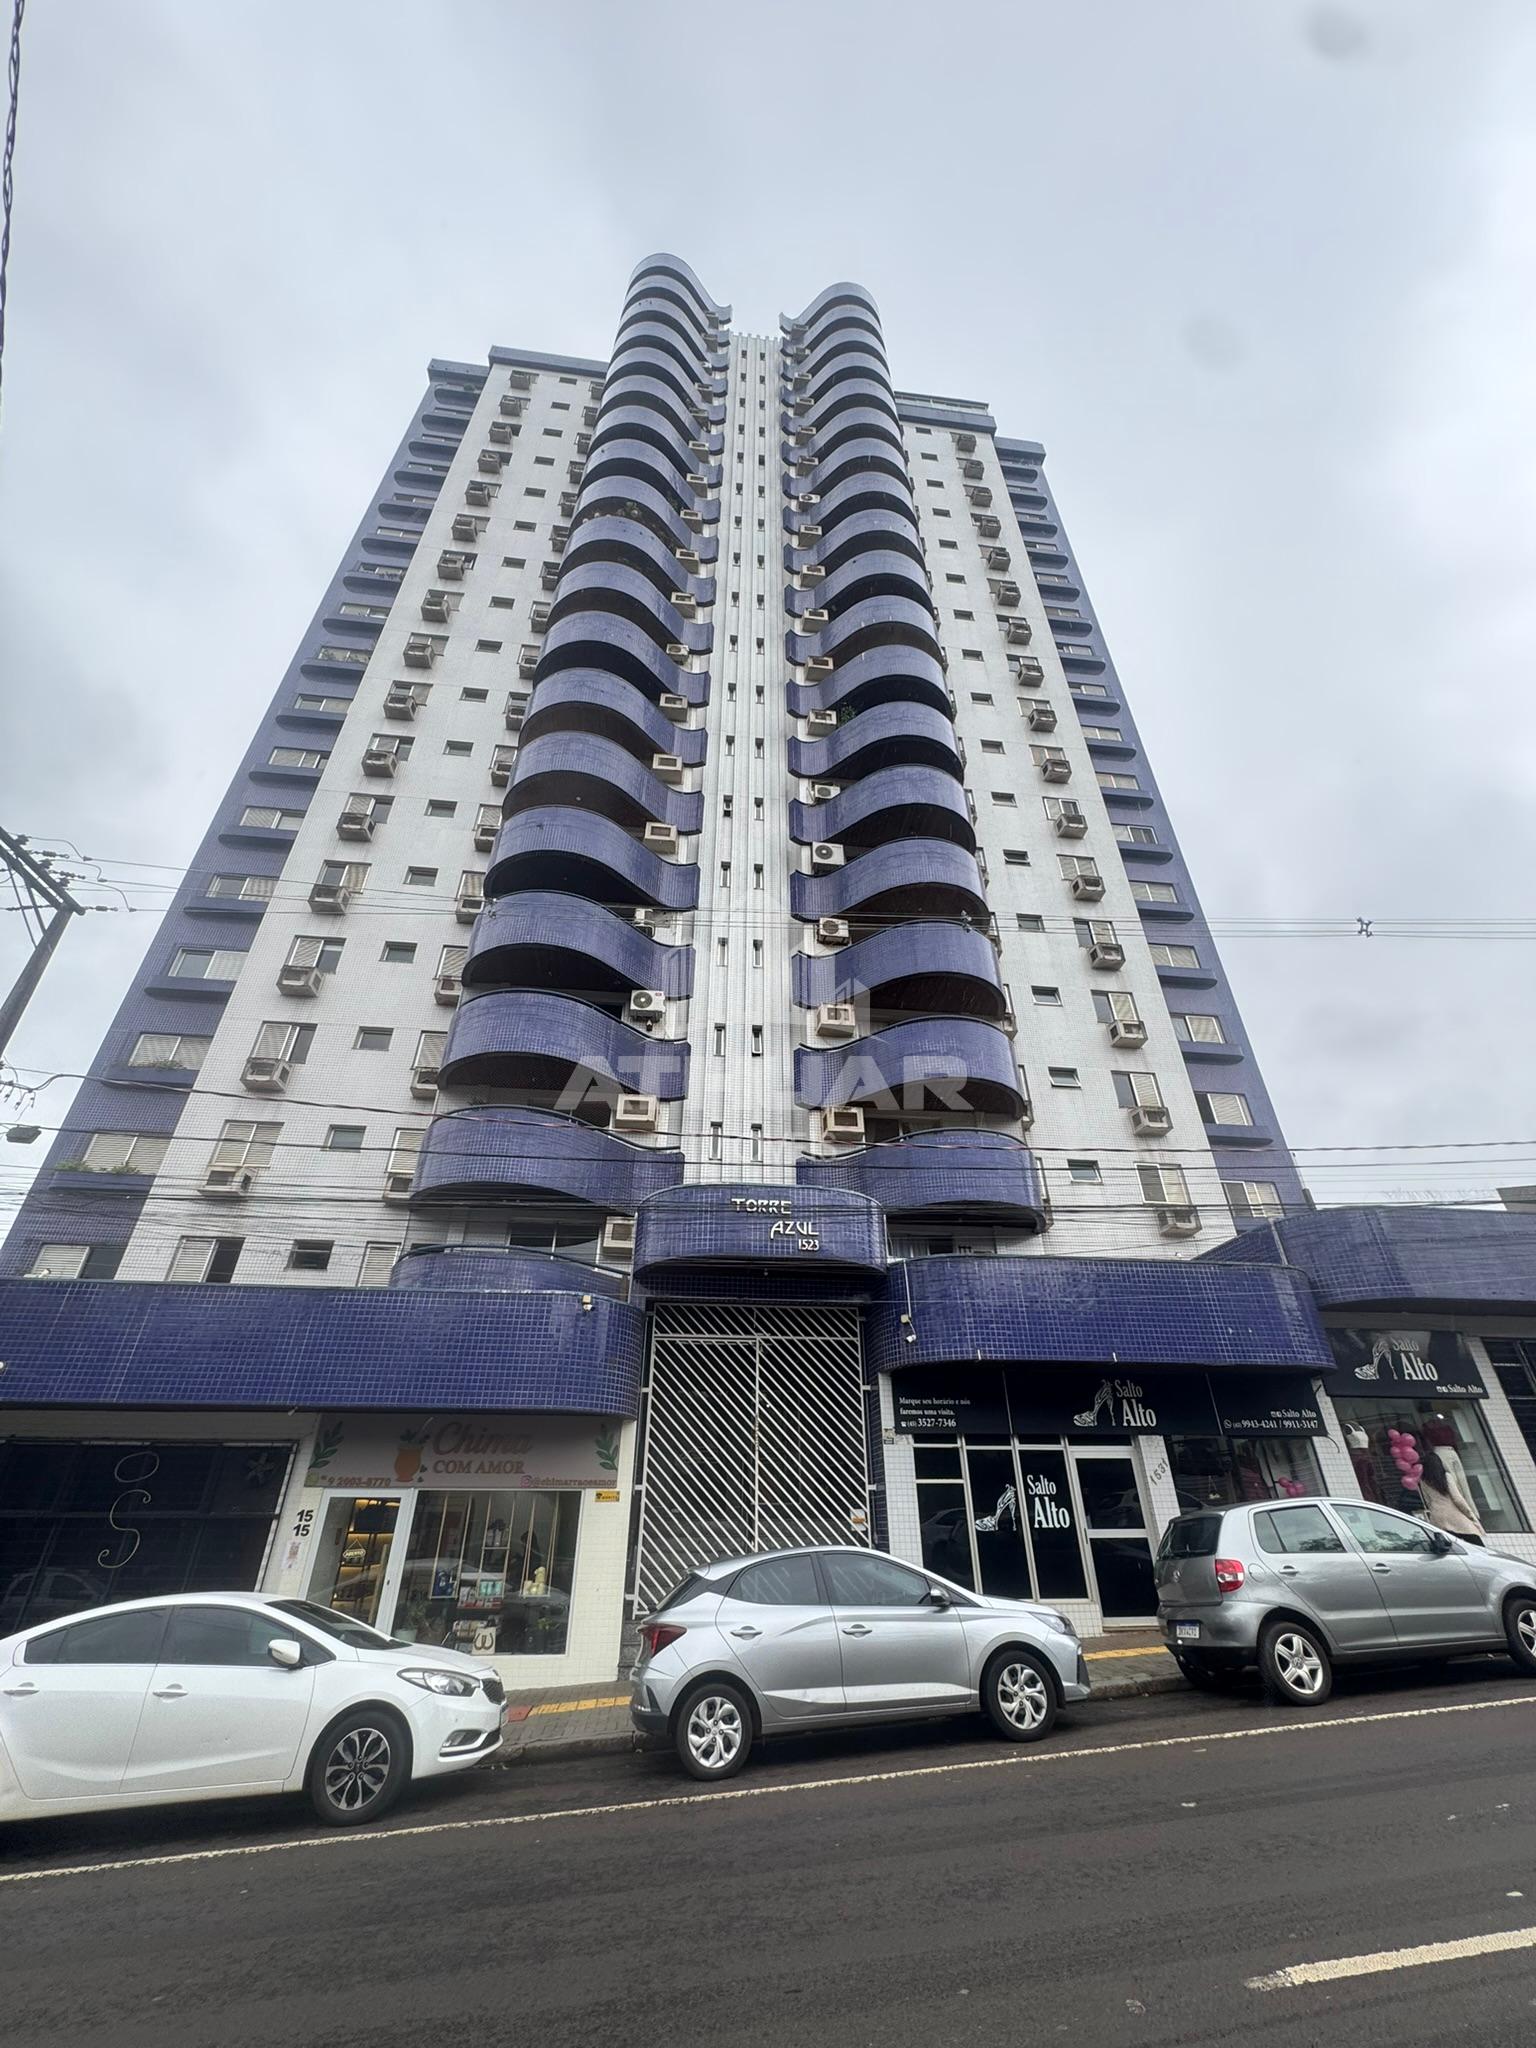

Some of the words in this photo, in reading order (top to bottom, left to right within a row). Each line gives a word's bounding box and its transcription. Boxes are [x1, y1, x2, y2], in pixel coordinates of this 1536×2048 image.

[731, 1198, 792, 1214] TORRE
[770, 1220, 820, 1239] AZUL
[798, 1239, 820, 1251] 1523
[1391, 1335, 1420, 1352] Salto
[1400, 1352, 1438, 1381] Alto
[1114, 1379, 1144, 1398] Salto
[1447, 1384, 1466, 1393] Salto
[1467, 1384, 1483, 1393] Alto
[900, 1407, 923, 1415] faremos
[1122, 1398, 1157, 1427] Alto
[1282, 1409, 1300, 1418] Salto
[1301, 1409, 1317, 1418] Alto
[433, 1459, 472, 1474] COM
[474, 1459, 526, 1475] AMOR
[1027, 1475, 1057, 1496] Salto
[296, 1509, 314, 1523] 15
[1034, 1497, 1070, 1528] Alto
[292, 1524, 311, 1537] 15
